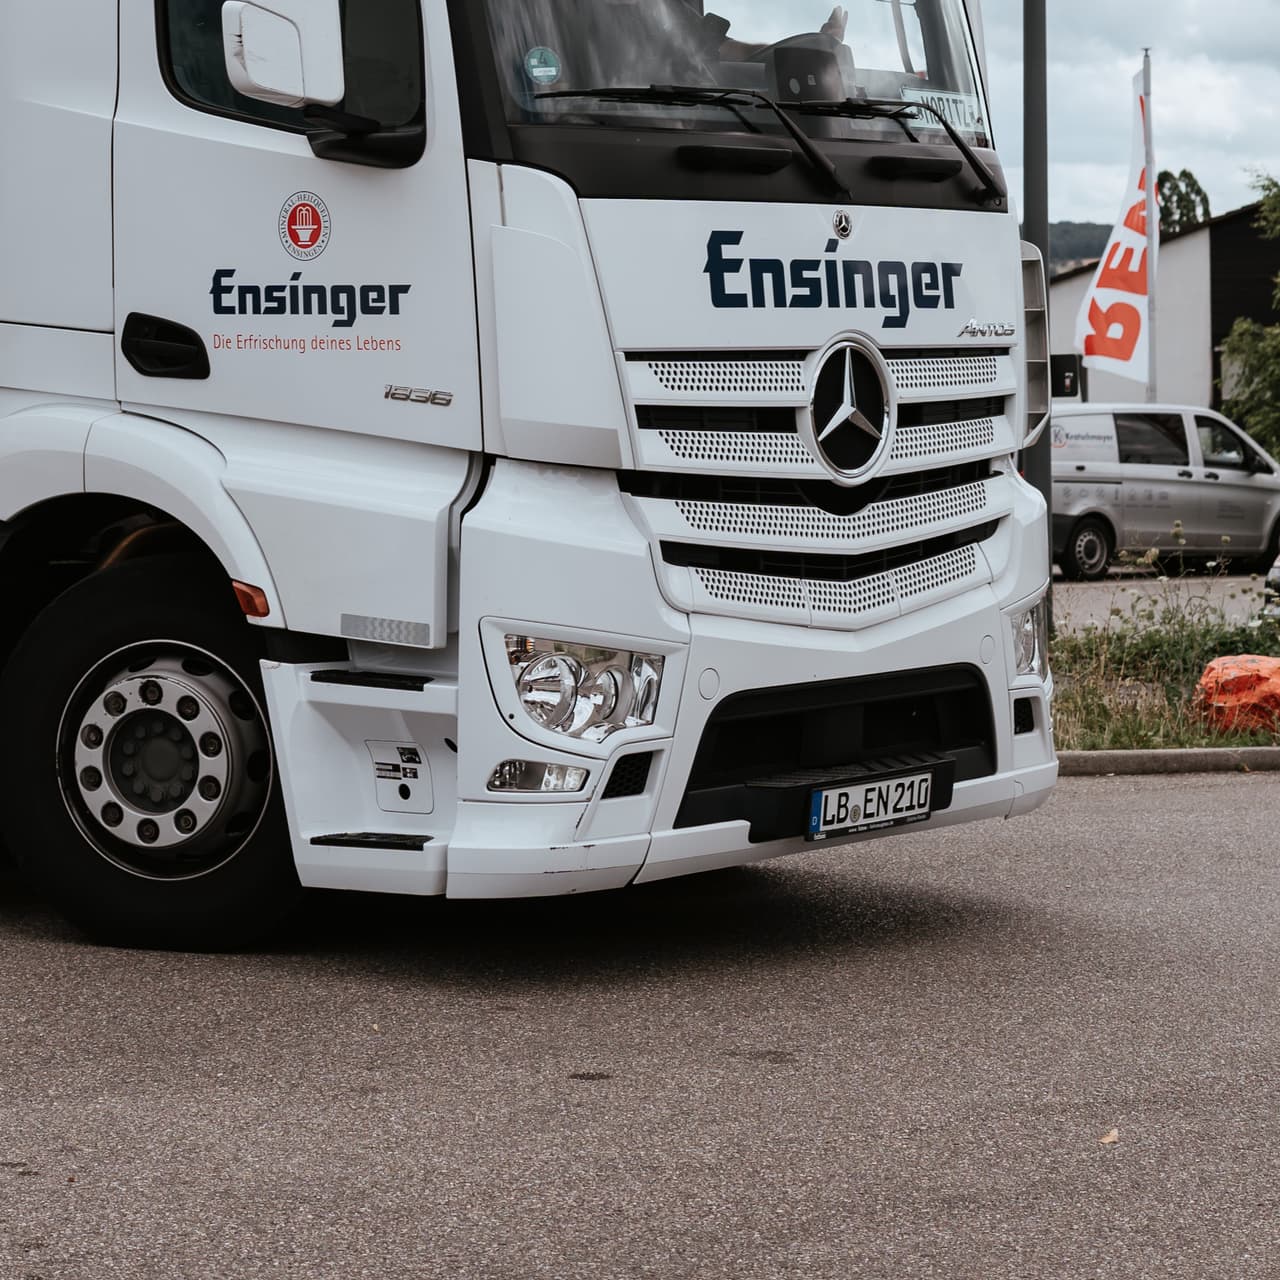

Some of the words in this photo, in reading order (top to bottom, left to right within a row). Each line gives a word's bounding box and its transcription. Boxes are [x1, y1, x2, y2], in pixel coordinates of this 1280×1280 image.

[703, 230, 963, 328] Ensinger
[209, 269, 412, 328] Ensinger
[213, 334, 232, 350] Die
[236, 334, 306, 353] Erfrischung
[311, 335, 352, 351] deines
[356, 336, 402, 351] Lebens
[383, 384, 453, 407] 1836
[822, 792, 849, 826] LB
